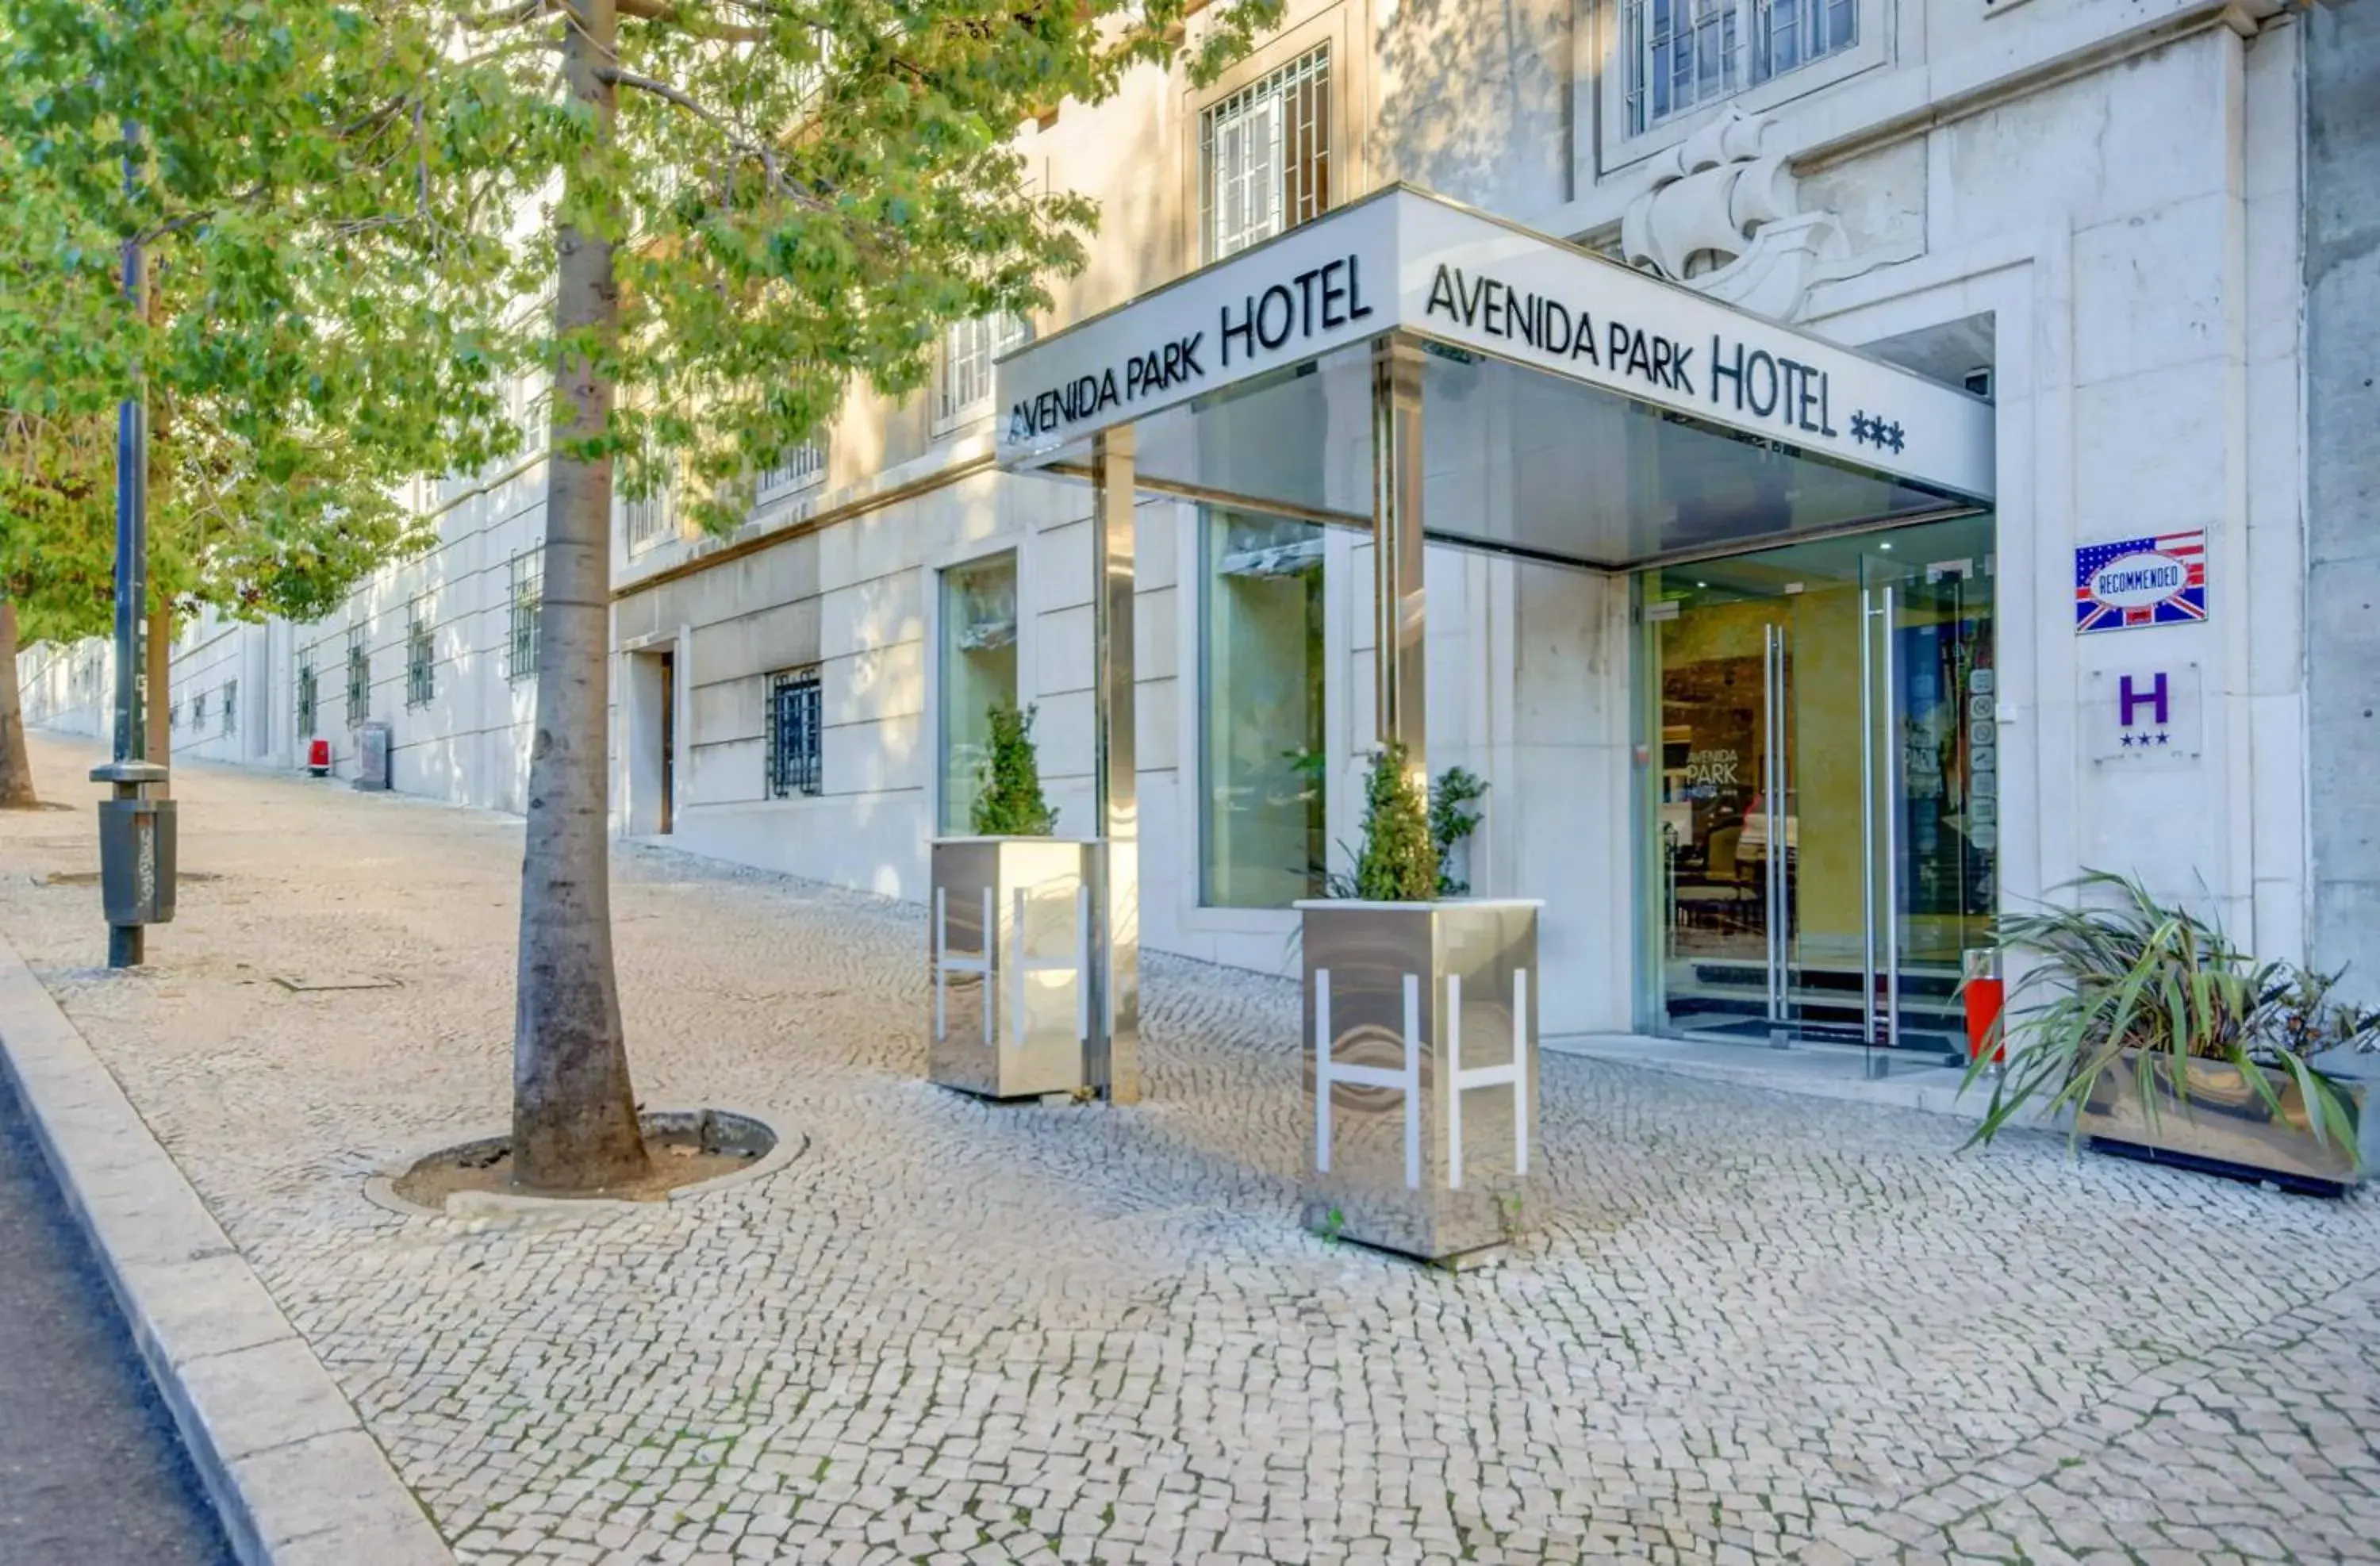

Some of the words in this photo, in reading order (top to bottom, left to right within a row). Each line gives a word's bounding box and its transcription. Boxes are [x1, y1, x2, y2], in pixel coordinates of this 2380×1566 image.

[1006, 367, 1122, 446] AVENIDA
[1127, 330, 1205, 401] PARK
[1221, 254, 1373, 367] HOTEL
[1426, 263, 1600, 367] AVENIDA
[1609, 320, 1695, 396] PARK
[1711, 334, 1838, 438] HOTEL
[2098, 564, 2178, 594] RECOMMENDED
[2119, 672, 2169, 727] H
[1686, 762, 1738, 785] PARK
